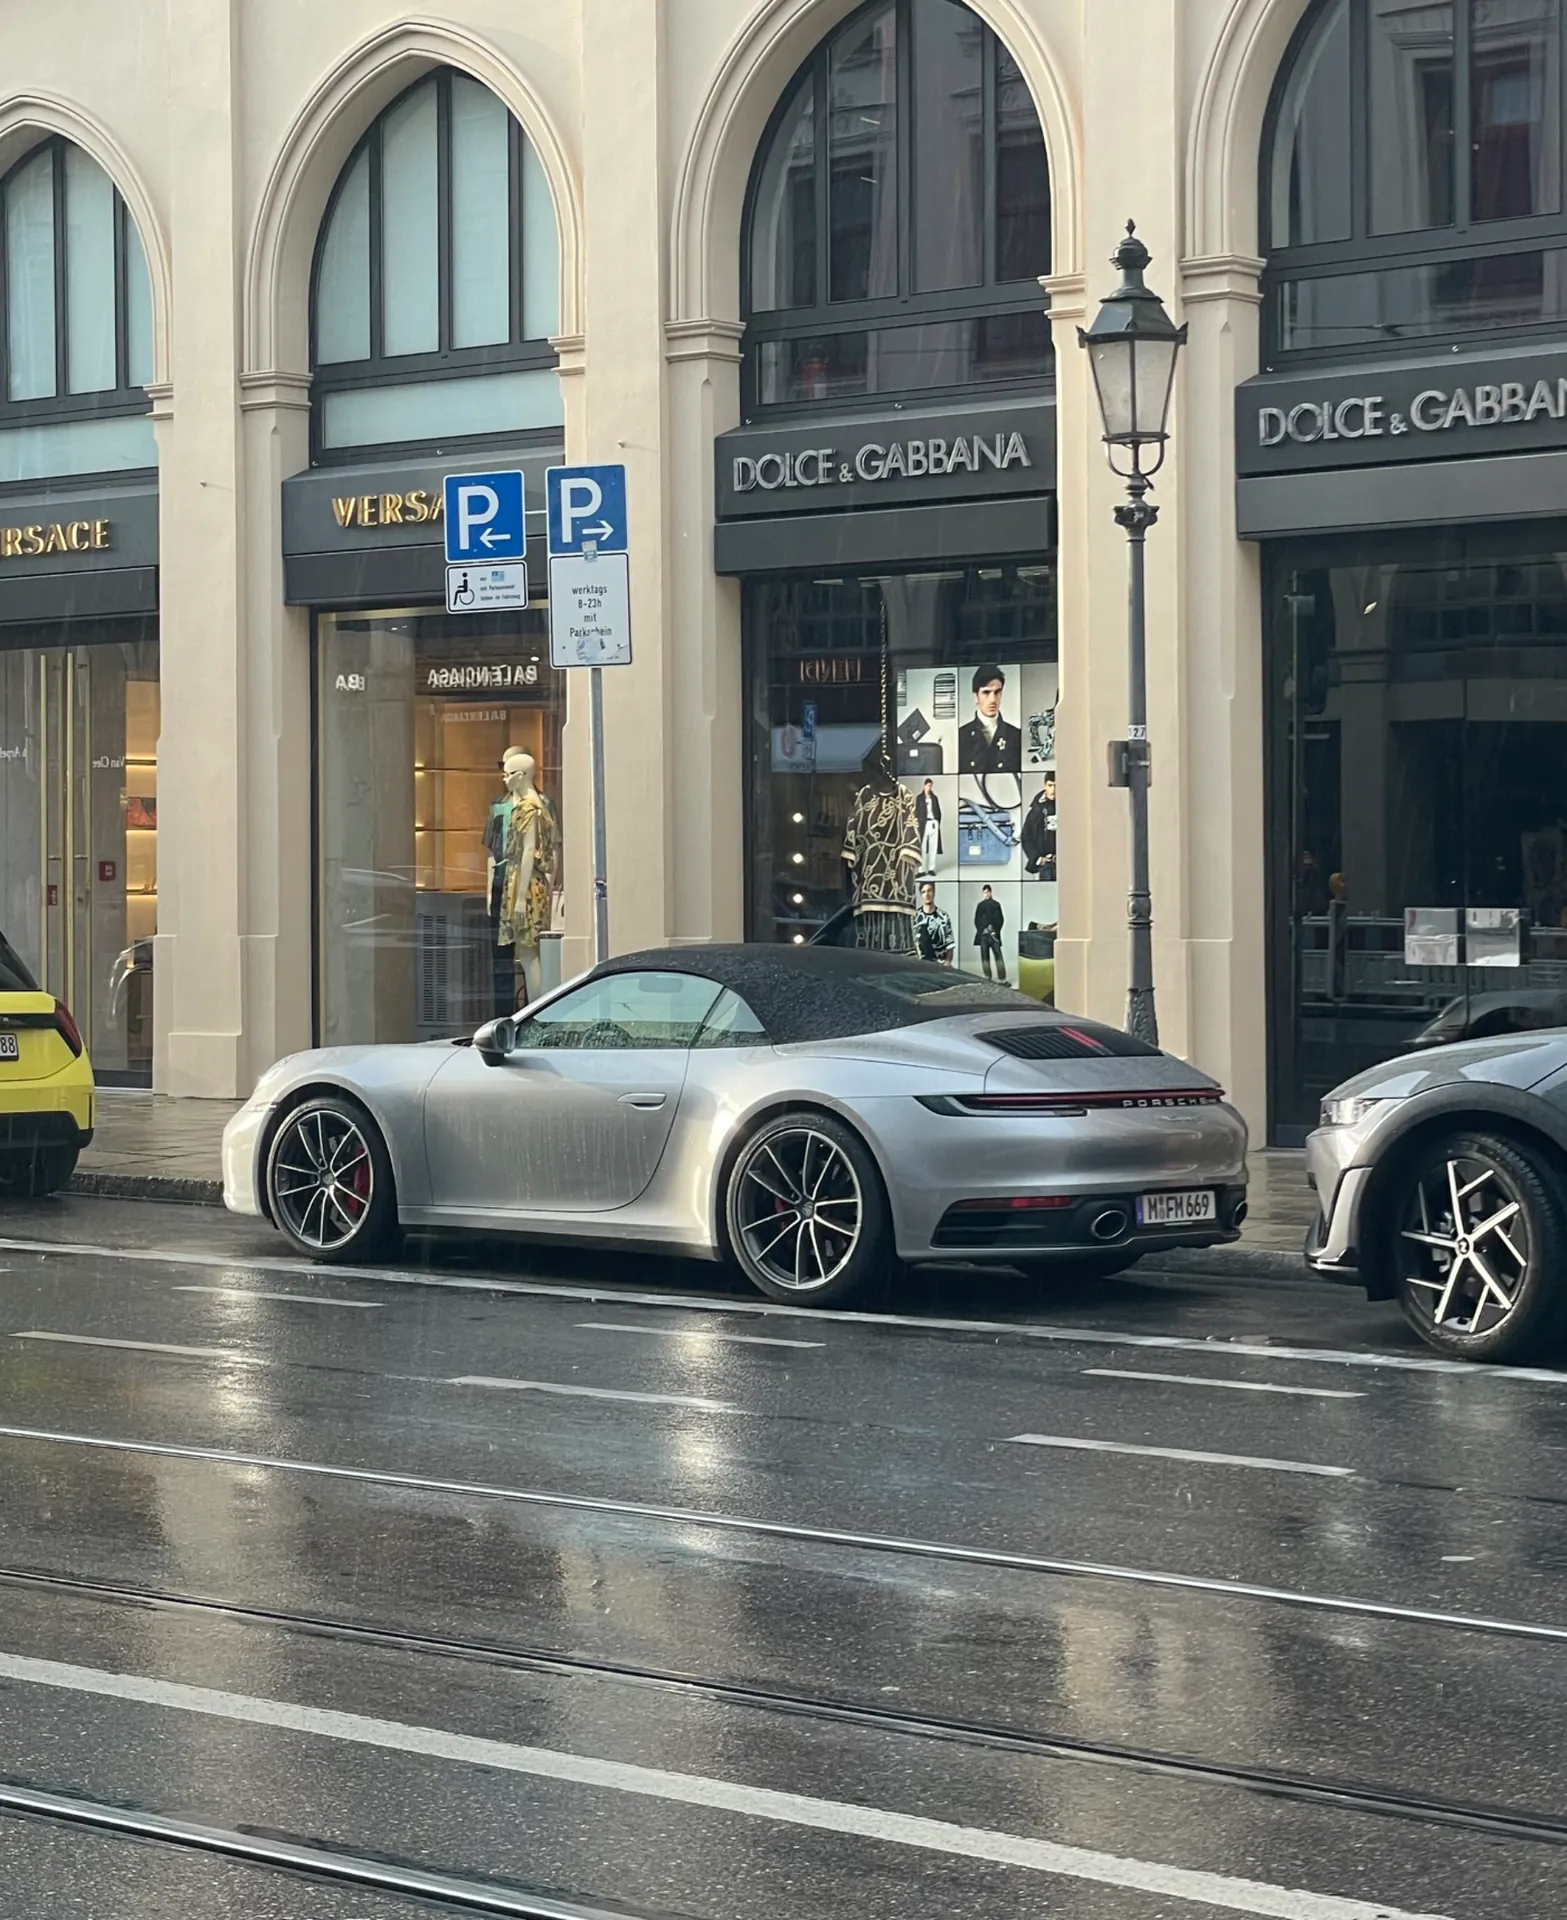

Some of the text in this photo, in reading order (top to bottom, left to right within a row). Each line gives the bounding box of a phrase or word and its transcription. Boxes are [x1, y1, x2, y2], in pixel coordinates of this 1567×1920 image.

[1258, 378, 1567, 446] DOLCE & GABBA
[733, 431, 1032, 491] DOLCE & GABBANA
[458, 485, 499, 550] P
[560, 477, 602, 543] P
[571, 585, 608, 596] werktags
[578, 598, 602, 609] 8-23h
[583, 613, 597, 623] mit
[1122, 1097, 1207, 1107] PORSCHE
[1147, 1197, 1158, 1220] M
